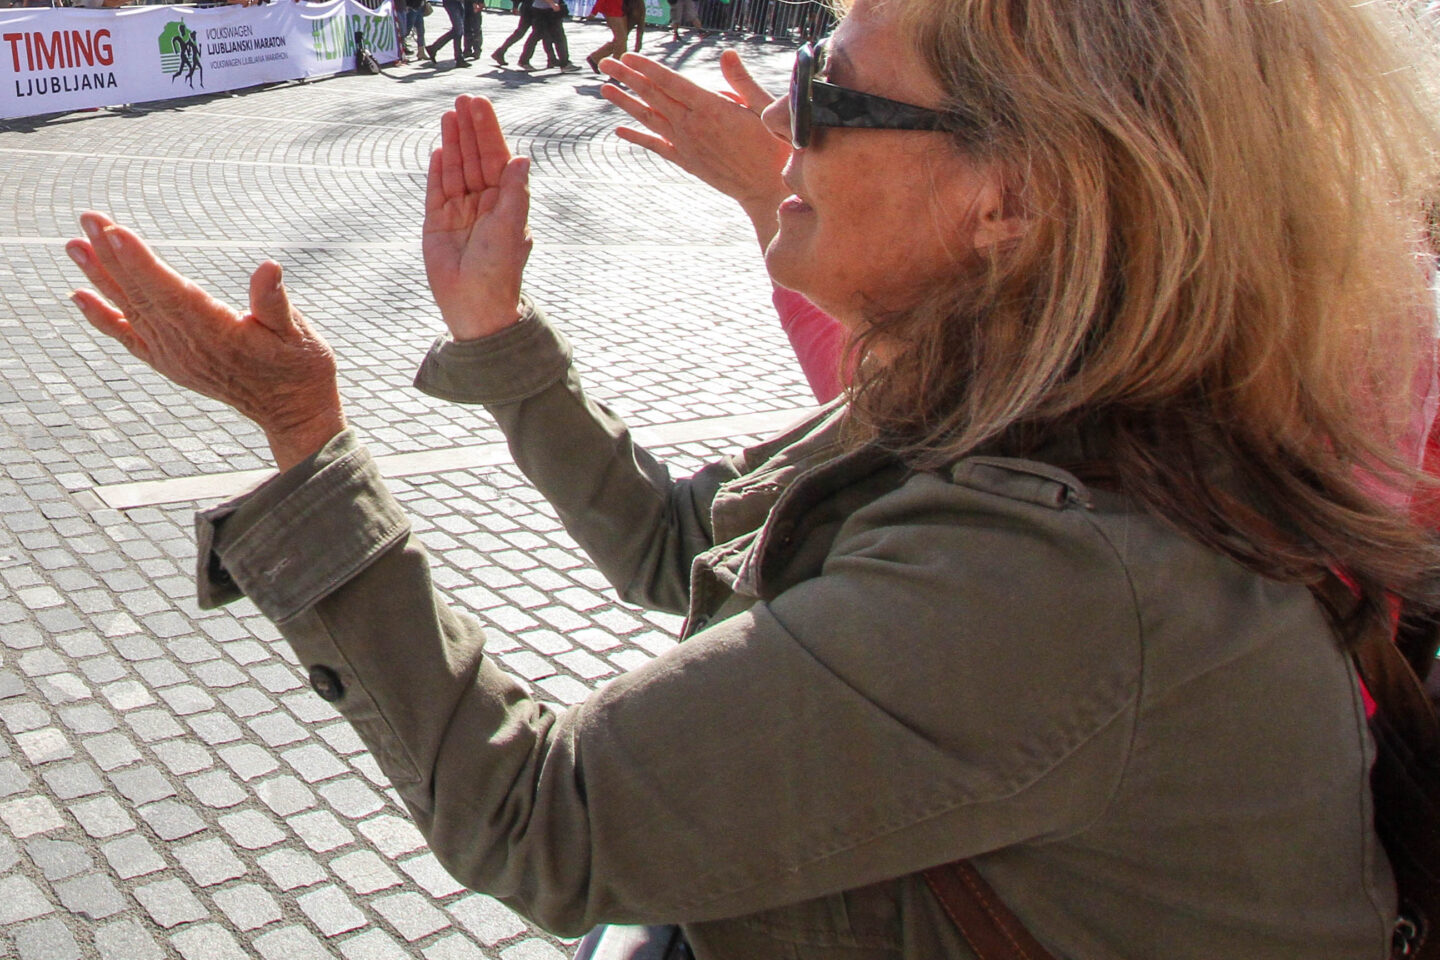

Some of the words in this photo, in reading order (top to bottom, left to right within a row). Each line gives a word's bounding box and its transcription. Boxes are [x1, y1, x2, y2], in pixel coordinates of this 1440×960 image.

[206, 25, 253, 40] VOLKSWAGEN
[3, 28, 114, 72] TIMING
[207, 40, 253, 55] LJUBLJANSKI
[254, 36, 286, 49] MARATON
[210, 60, 242, 70] VOLKSWAGEN
[15, 72, 118, 97] LJUBLJANA
